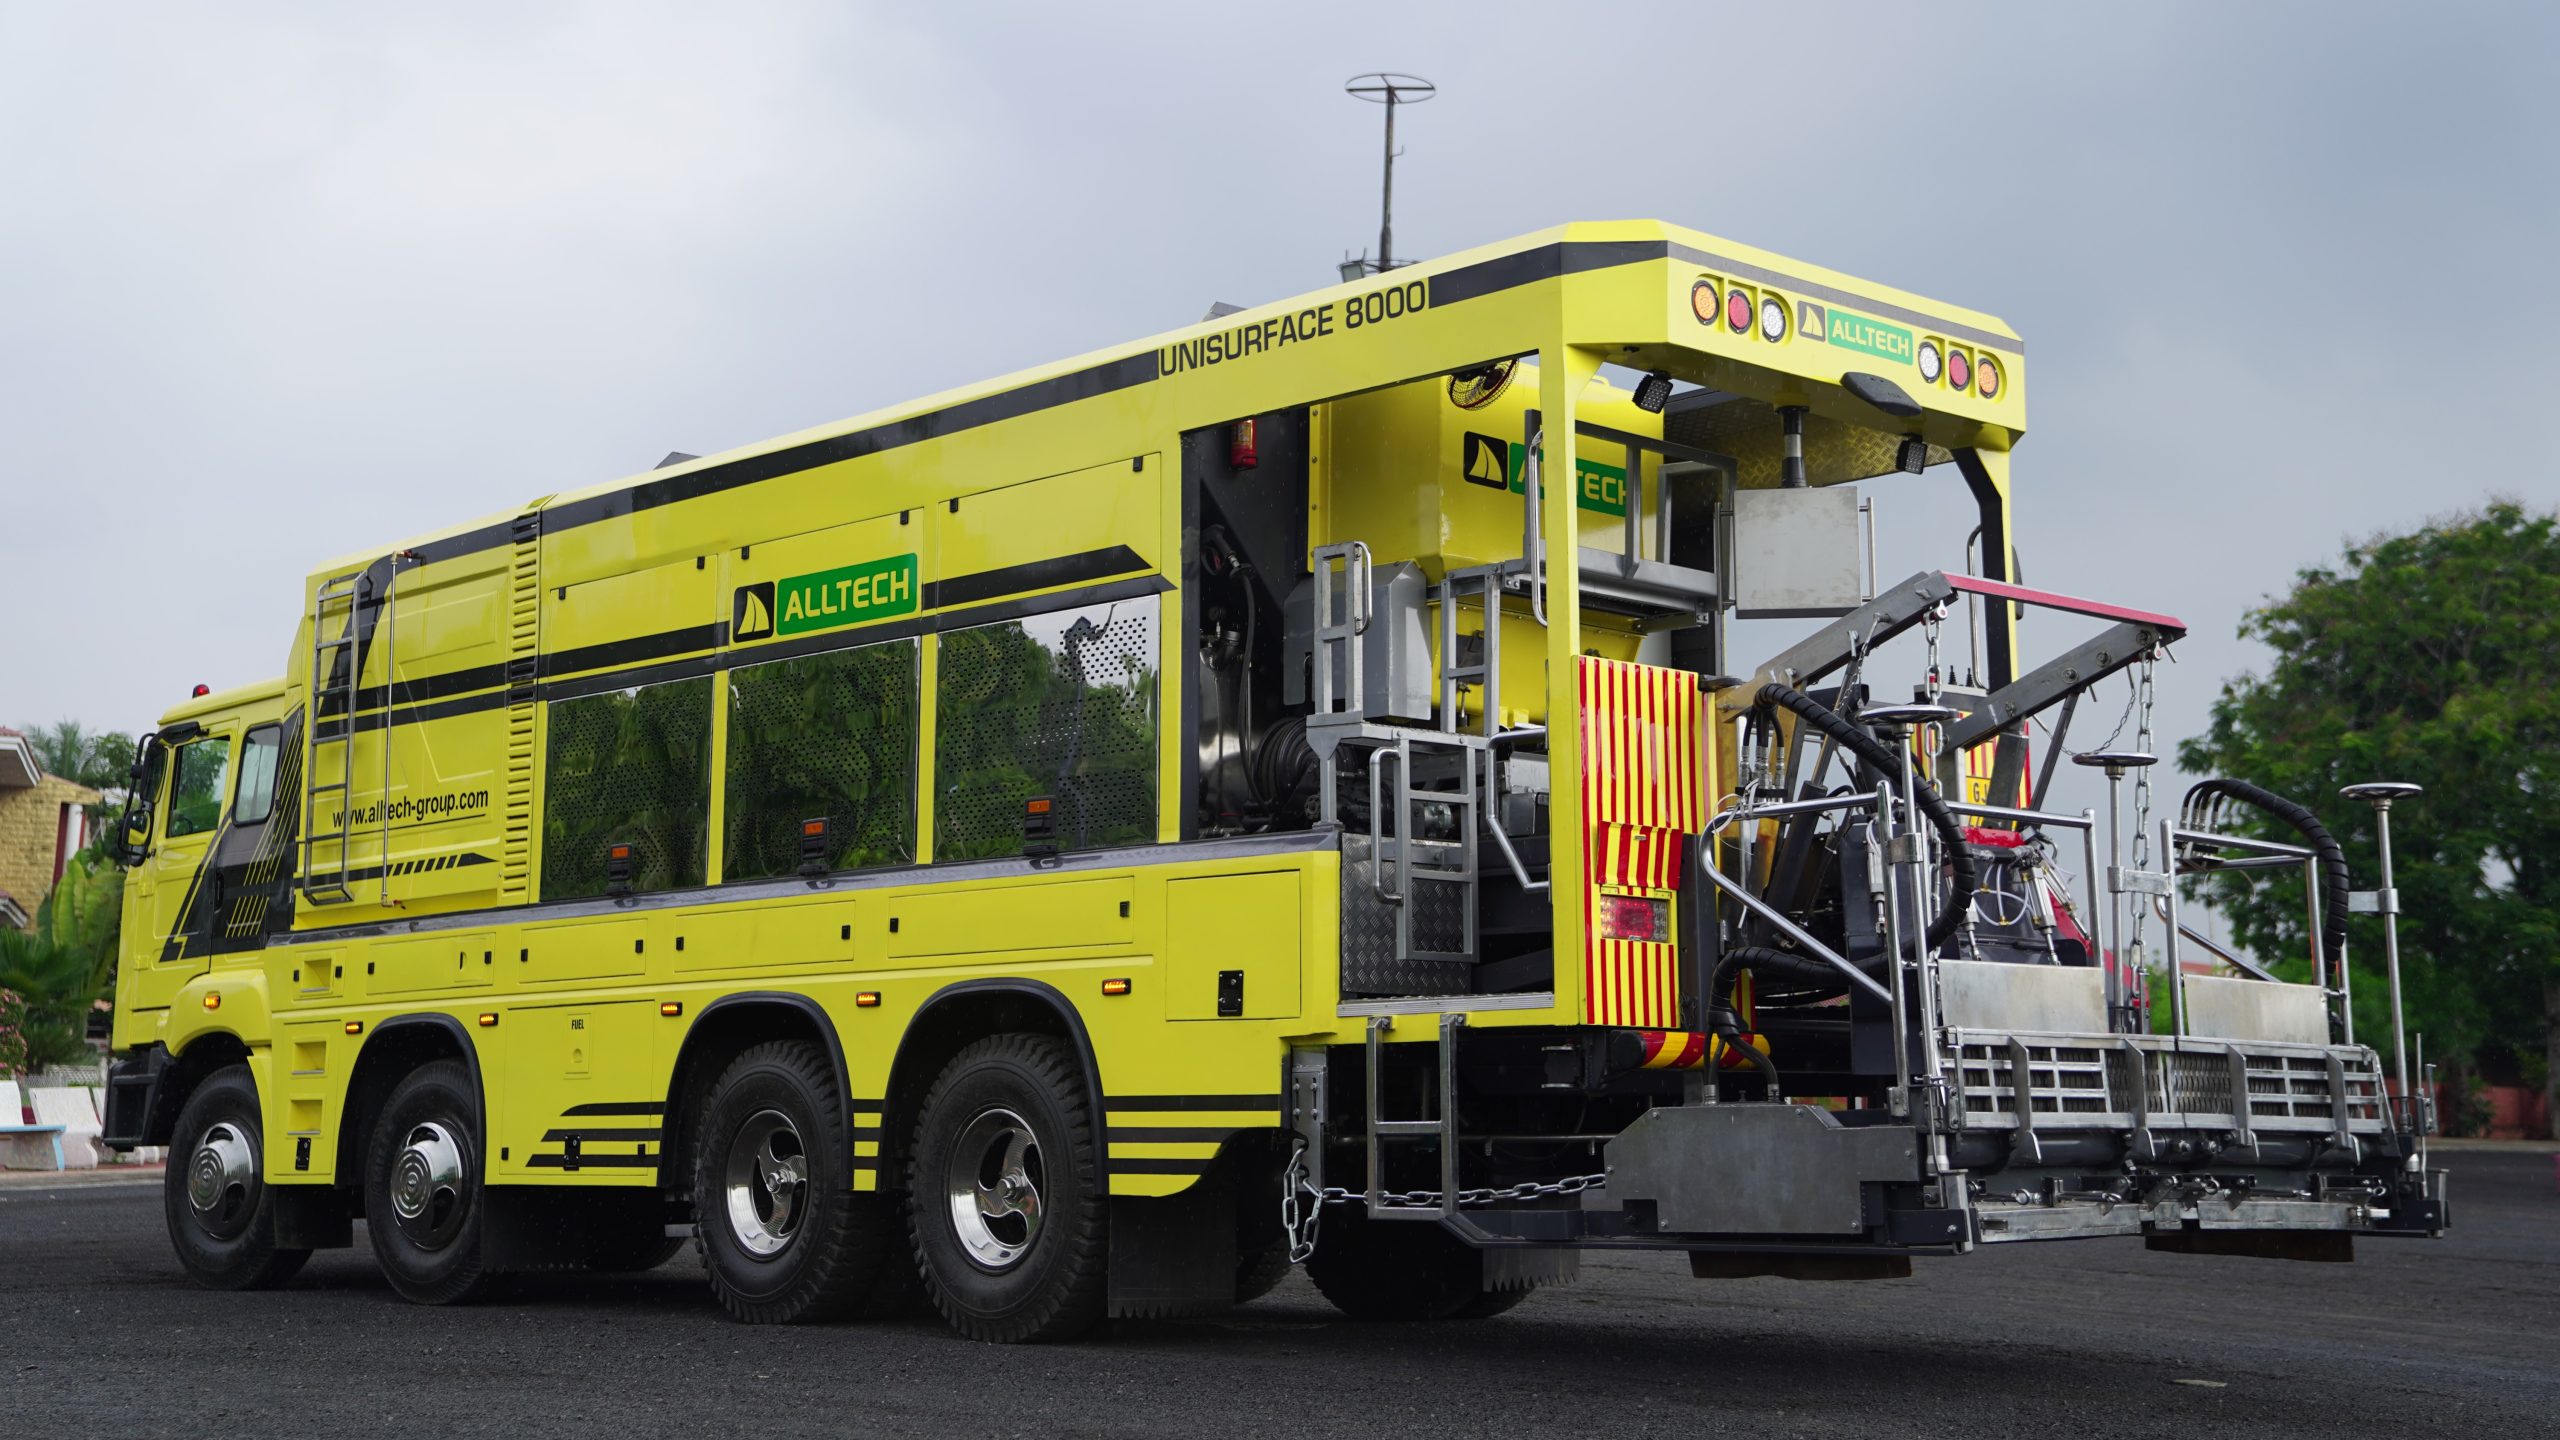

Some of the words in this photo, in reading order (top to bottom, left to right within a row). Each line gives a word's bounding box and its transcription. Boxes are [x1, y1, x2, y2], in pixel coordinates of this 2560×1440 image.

[1159, 304, 1334, 377] UNISURFACE
[1345, 280, 1426, 330] 8000
[1831, 318, 1910, 358] ALLTECH
[783, 567, 910, 622] ALLTECH
[571, 1018, 584, 1030] FUEL
